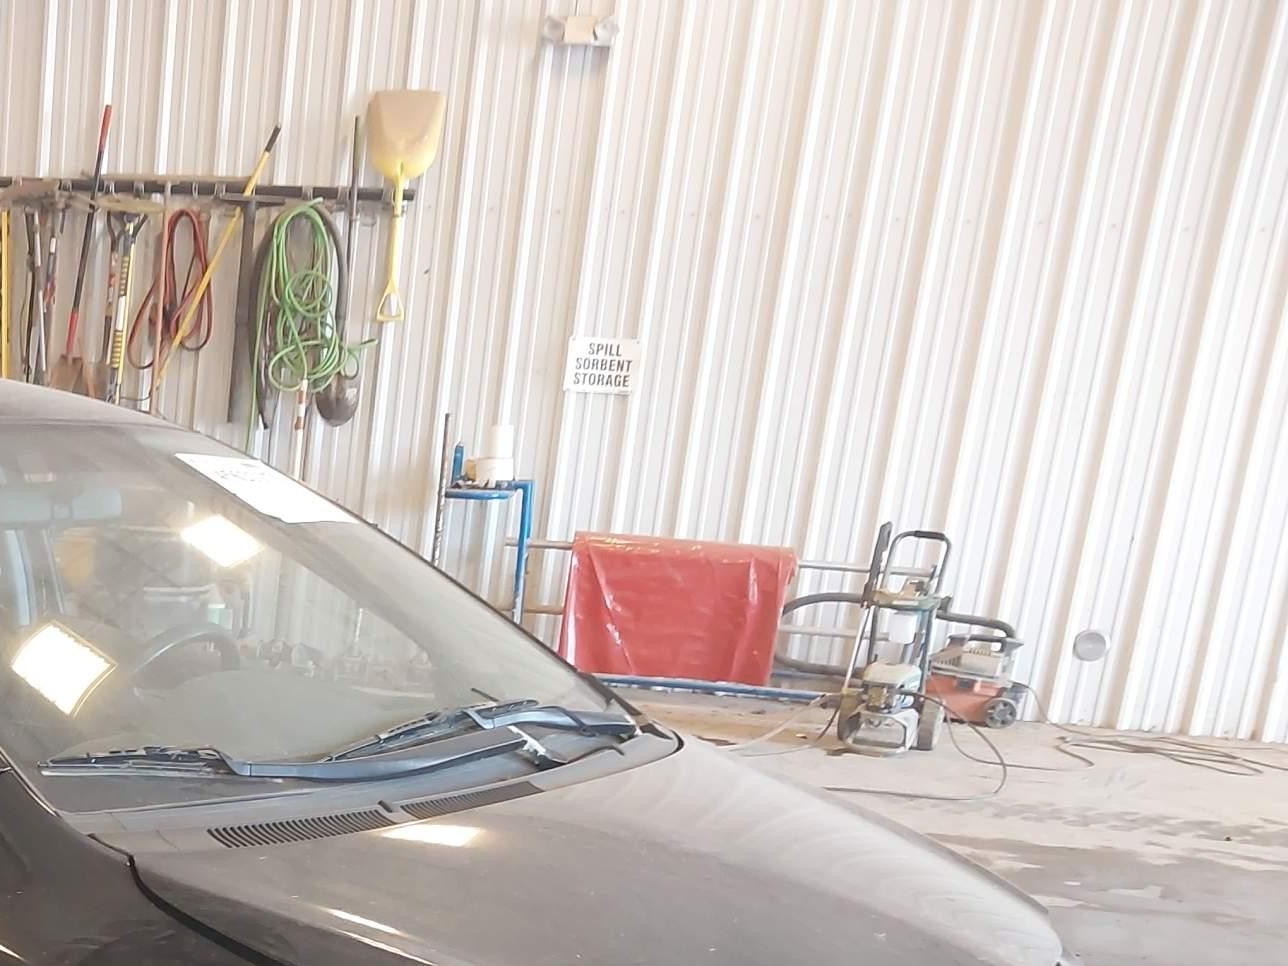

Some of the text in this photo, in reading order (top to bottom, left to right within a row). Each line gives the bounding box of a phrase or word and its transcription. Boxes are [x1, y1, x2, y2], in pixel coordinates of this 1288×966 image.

[588, 342, 622, 357] SPILL
[575, 357, 633, 372] SORBENT
[573, 372, 631, 387] STORAGE
